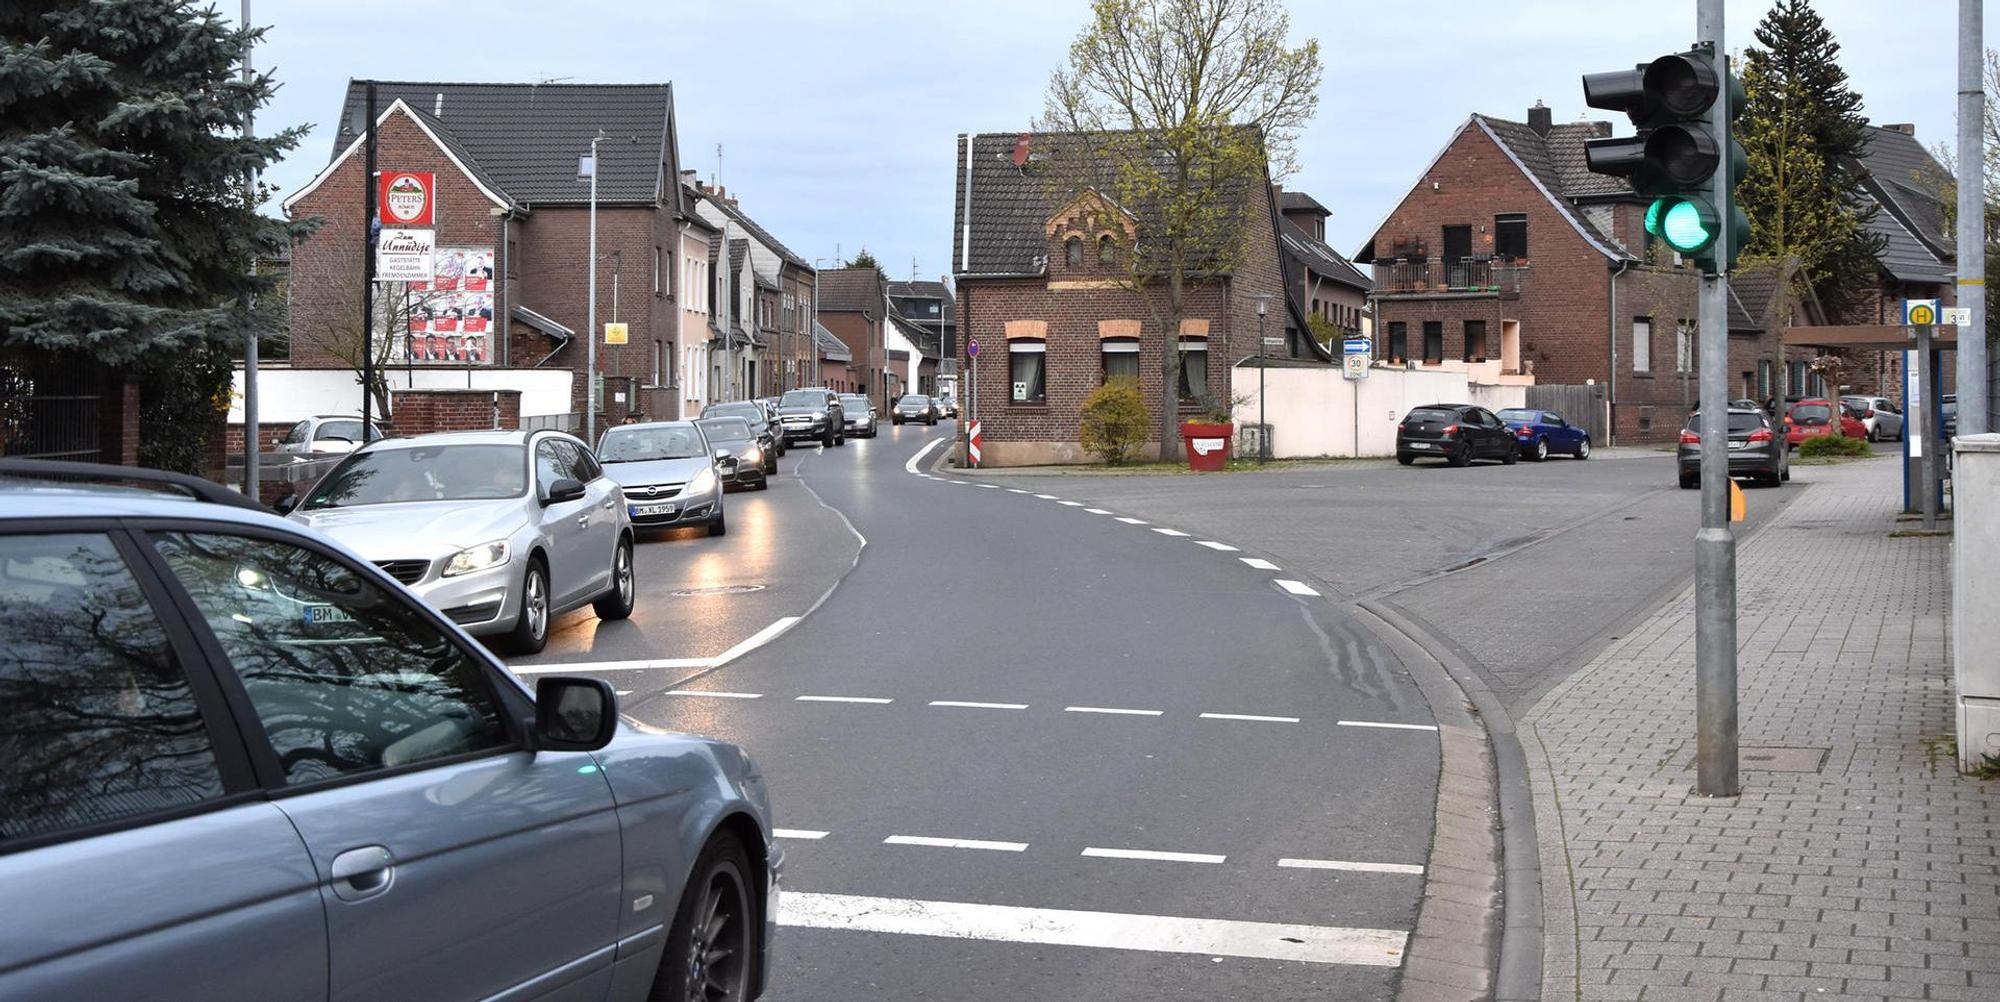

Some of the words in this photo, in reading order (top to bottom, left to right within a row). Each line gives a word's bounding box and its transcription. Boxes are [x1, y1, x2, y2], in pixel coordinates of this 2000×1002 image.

[391, 193, 422, 203] PETERS
[394, 231, 413, 240] Zum
[1916, 309, 1927, 322] H
[1351, 359, 1361, 368] 30
[313, 607, 333, 621] BM
